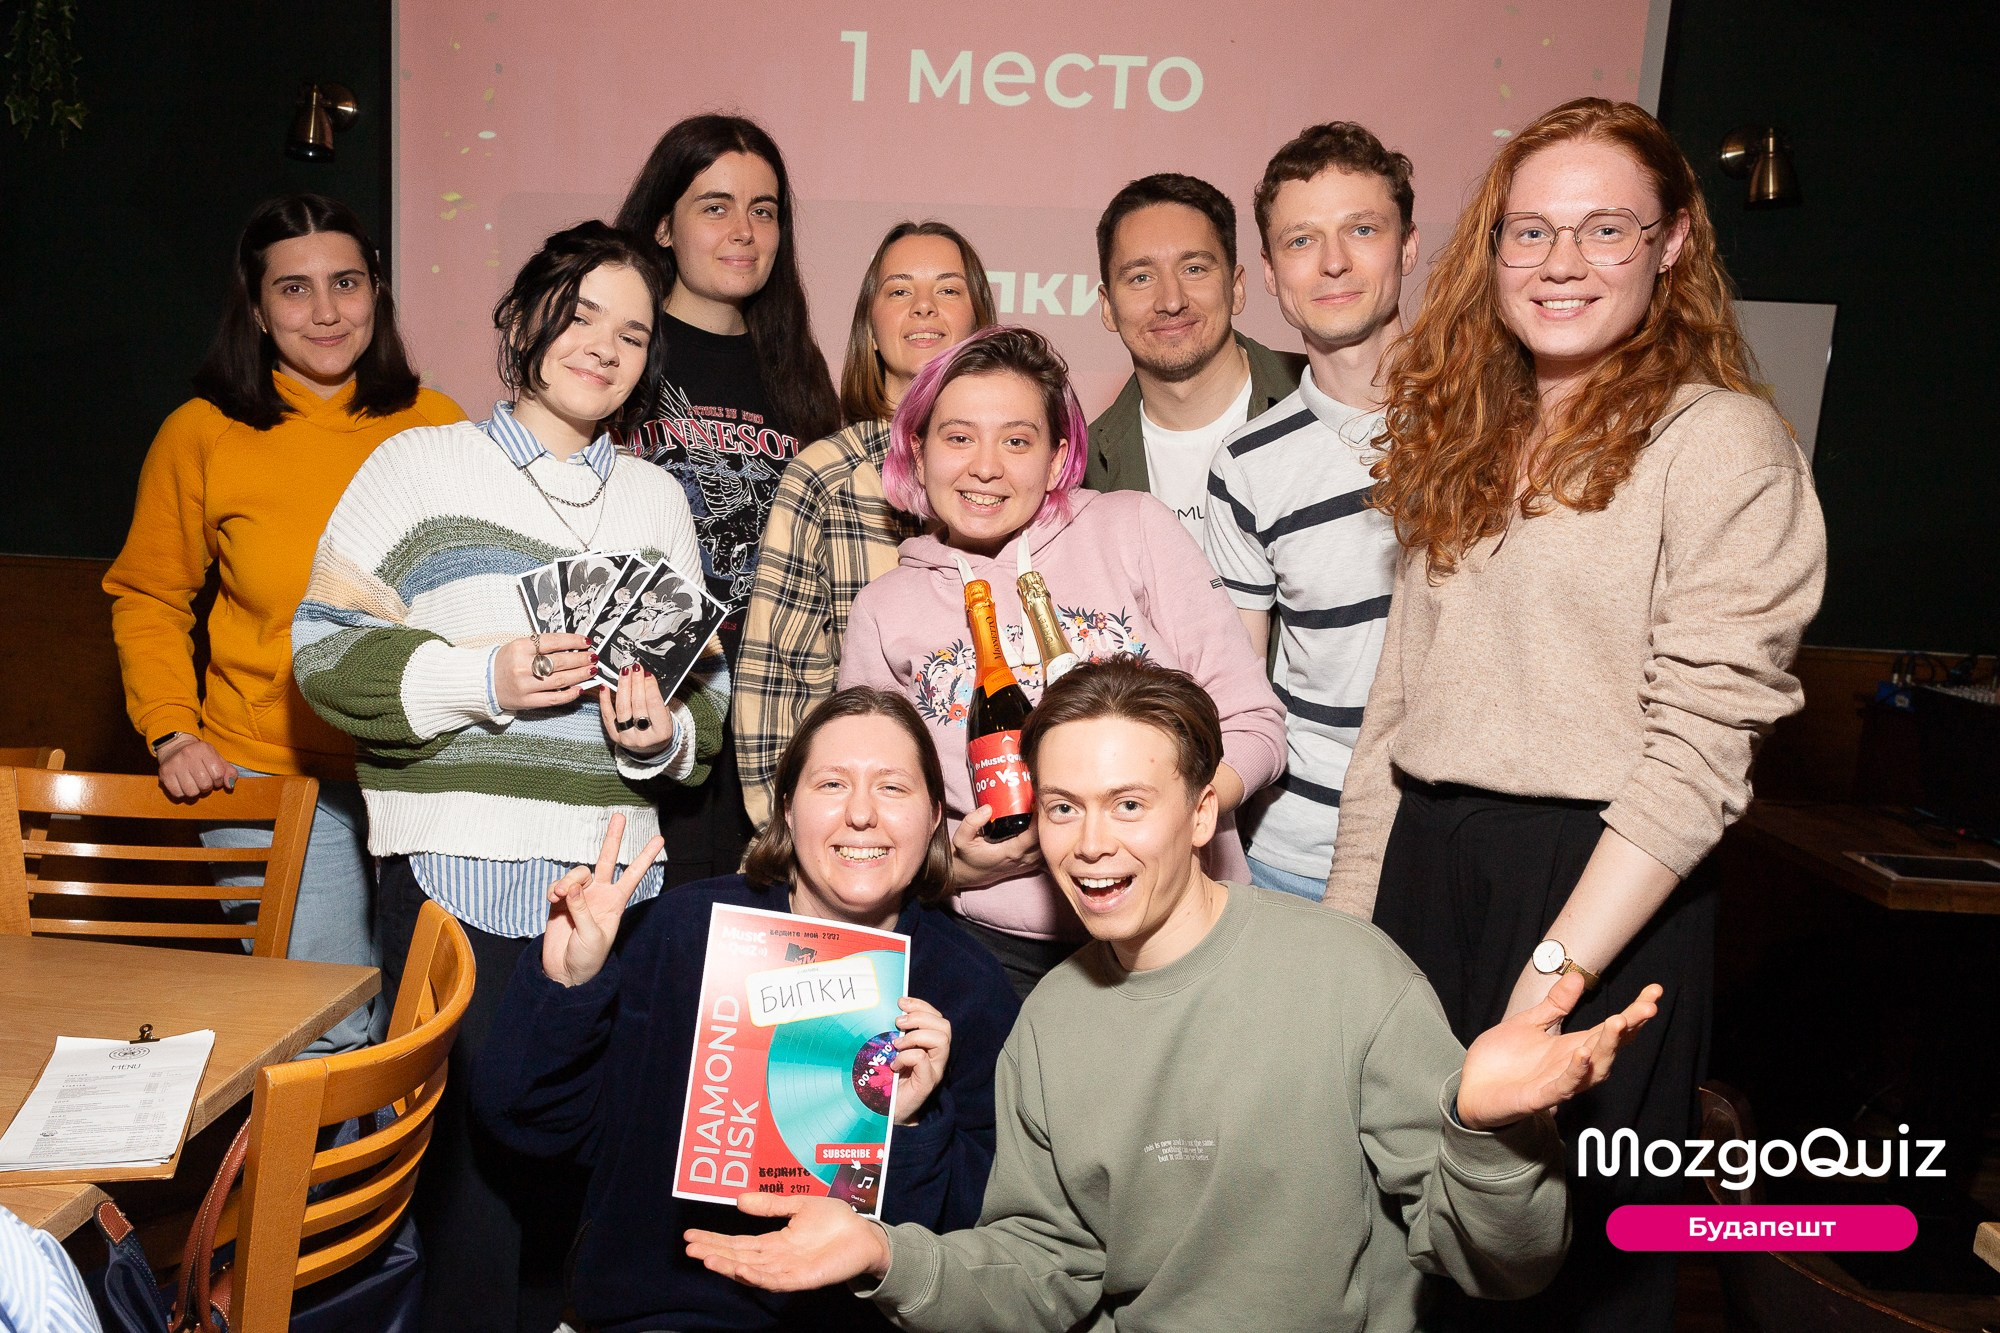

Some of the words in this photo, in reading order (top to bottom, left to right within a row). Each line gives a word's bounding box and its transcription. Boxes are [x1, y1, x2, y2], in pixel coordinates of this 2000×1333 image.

[841, 30, 867, 102] 1
[908, 49, 1204, 112] место
[607, 418, 799, 461] MINNESOT
[995, 768, 1021, 787] VS
[760, 976, 856, 1014] БИПКИ
[689, 995, 740, 1184] DIAMOND
[721, 1099, 759, 1189] DISK
[822, 1148, 871, 1159] SUBSCRIBE
[790, 1184, 810, 1194] 2017
